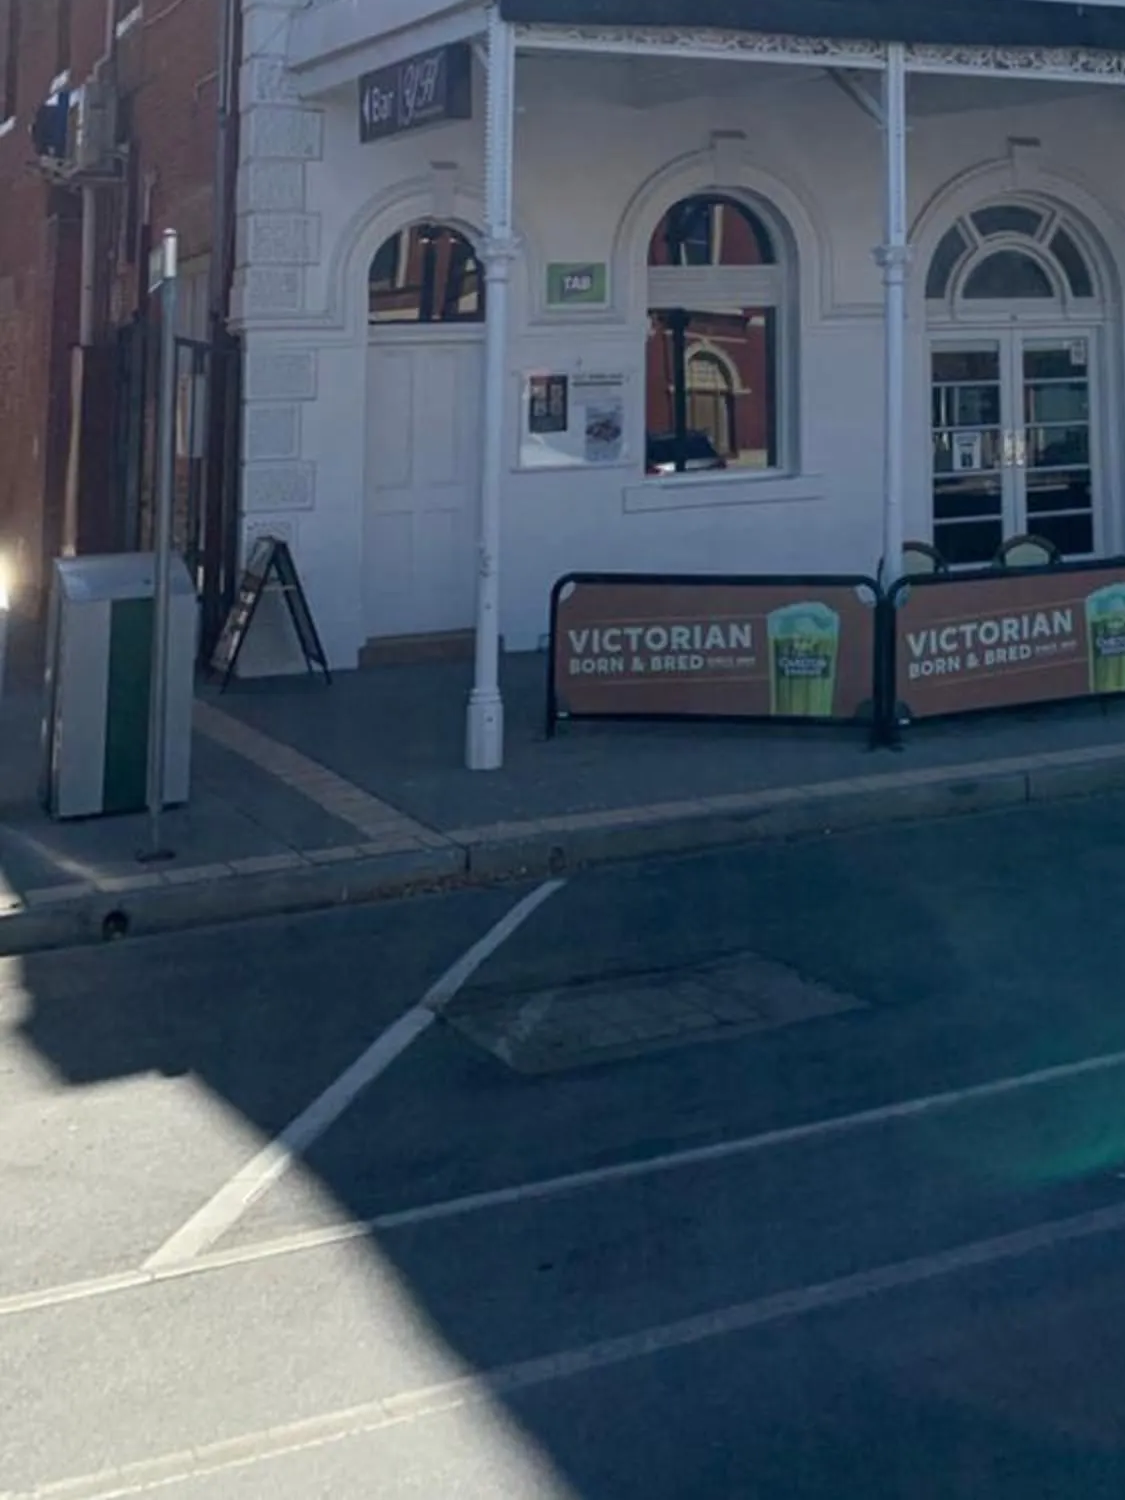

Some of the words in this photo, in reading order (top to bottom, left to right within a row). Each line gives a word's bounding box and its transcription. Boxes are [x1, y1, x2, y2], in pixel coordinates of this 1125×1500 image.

[371, 86, 395, 122] Bar
[563, 275, 592, 291] TAB
[567, 624, 752, 654] VICTORIAN
[906, 609, 1074, 657] VICTORIAN
[568, 657, 625, 676] BORN
[631, 656, 645, 673] &
[650, 655, 704, 672] BRED
[908, 655, 961, 679] BORN
[966, 652, 980, 669] &
[984, 643, 1032, 665] BRED
